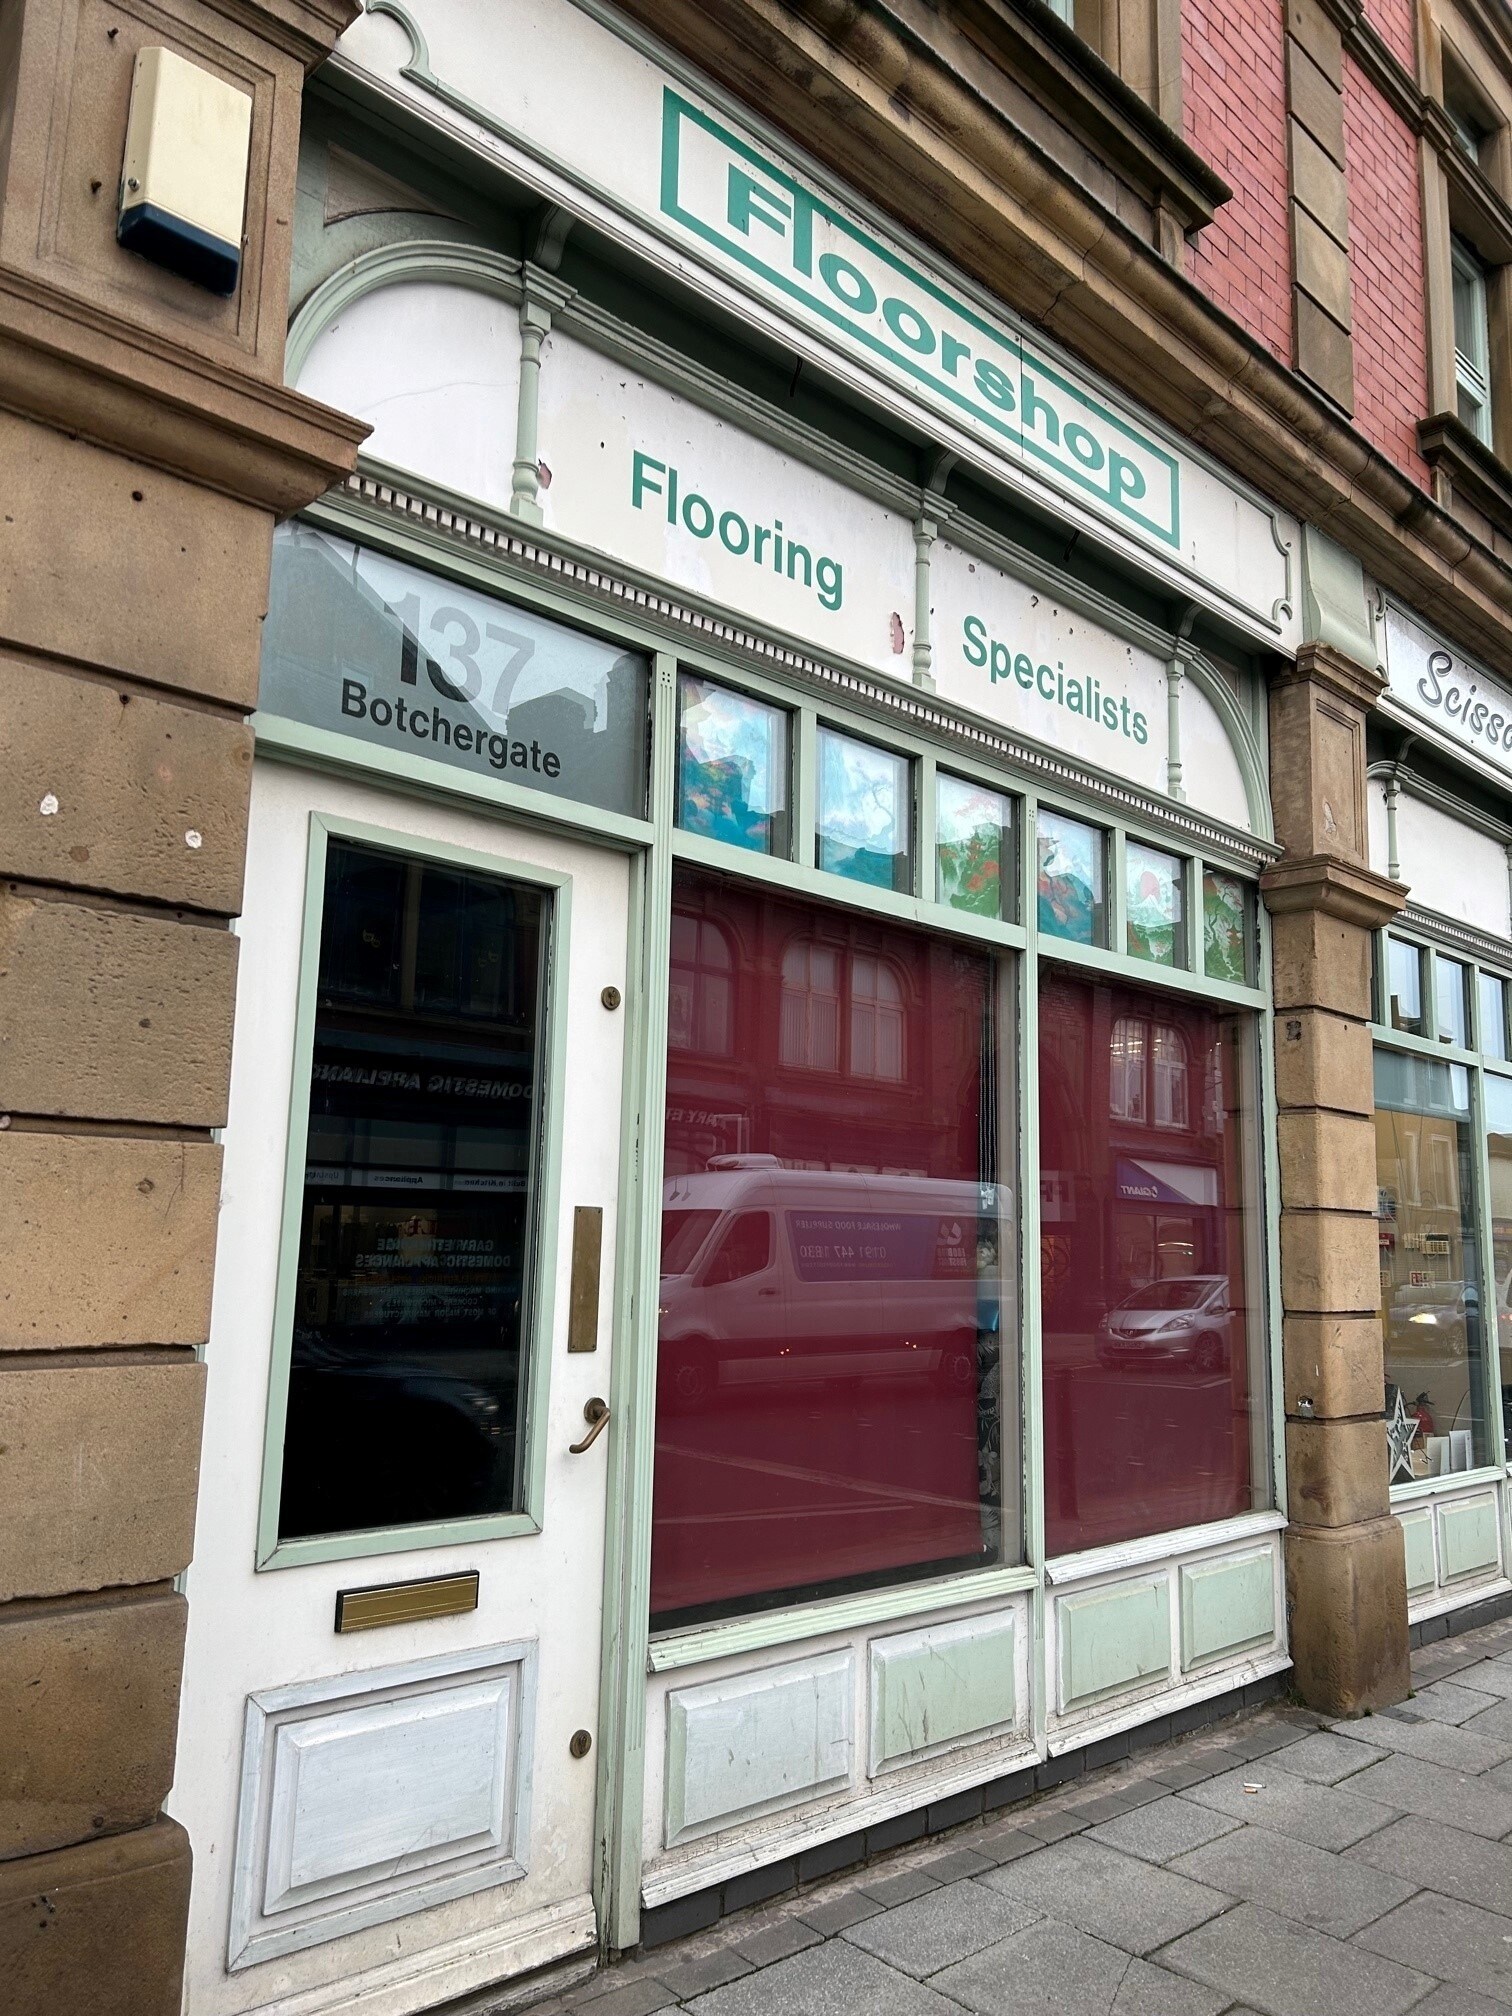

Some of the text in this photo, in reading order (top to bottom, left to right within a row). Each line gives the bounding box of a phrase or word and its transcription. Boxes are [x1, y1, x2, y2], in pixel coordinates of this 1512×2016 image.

[726, 161, 1148, 504] Floorshop
[383, 590, 536, 720] 137
[631, 449, 1149, 746] Flooring Specialists
[341, 677, 562, 778] Botchergate
